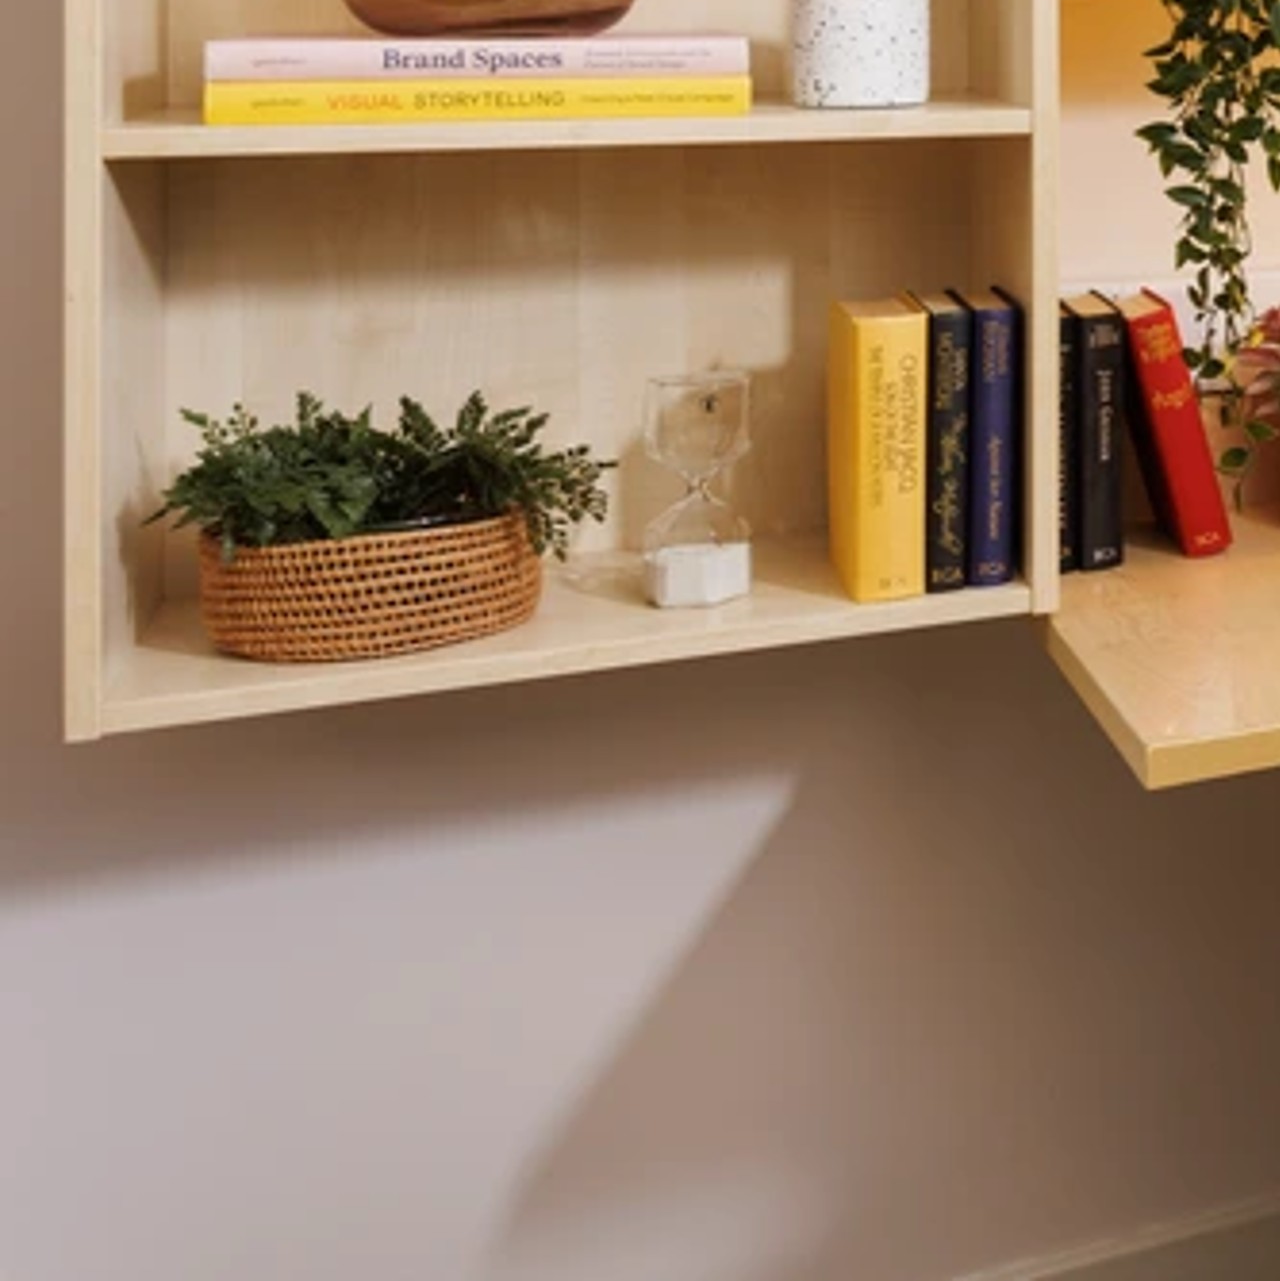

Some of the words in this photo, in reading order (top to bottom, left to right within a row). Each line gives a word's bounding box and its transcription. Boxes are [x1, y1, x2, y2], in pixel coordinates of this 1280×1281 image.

[382, 47, 466, 71] Brand
[473, 48, 563, 75] Spaces
[326, 92, 402, 112] VISUAL
[412, 89, 566, 110] STORYTELLING
